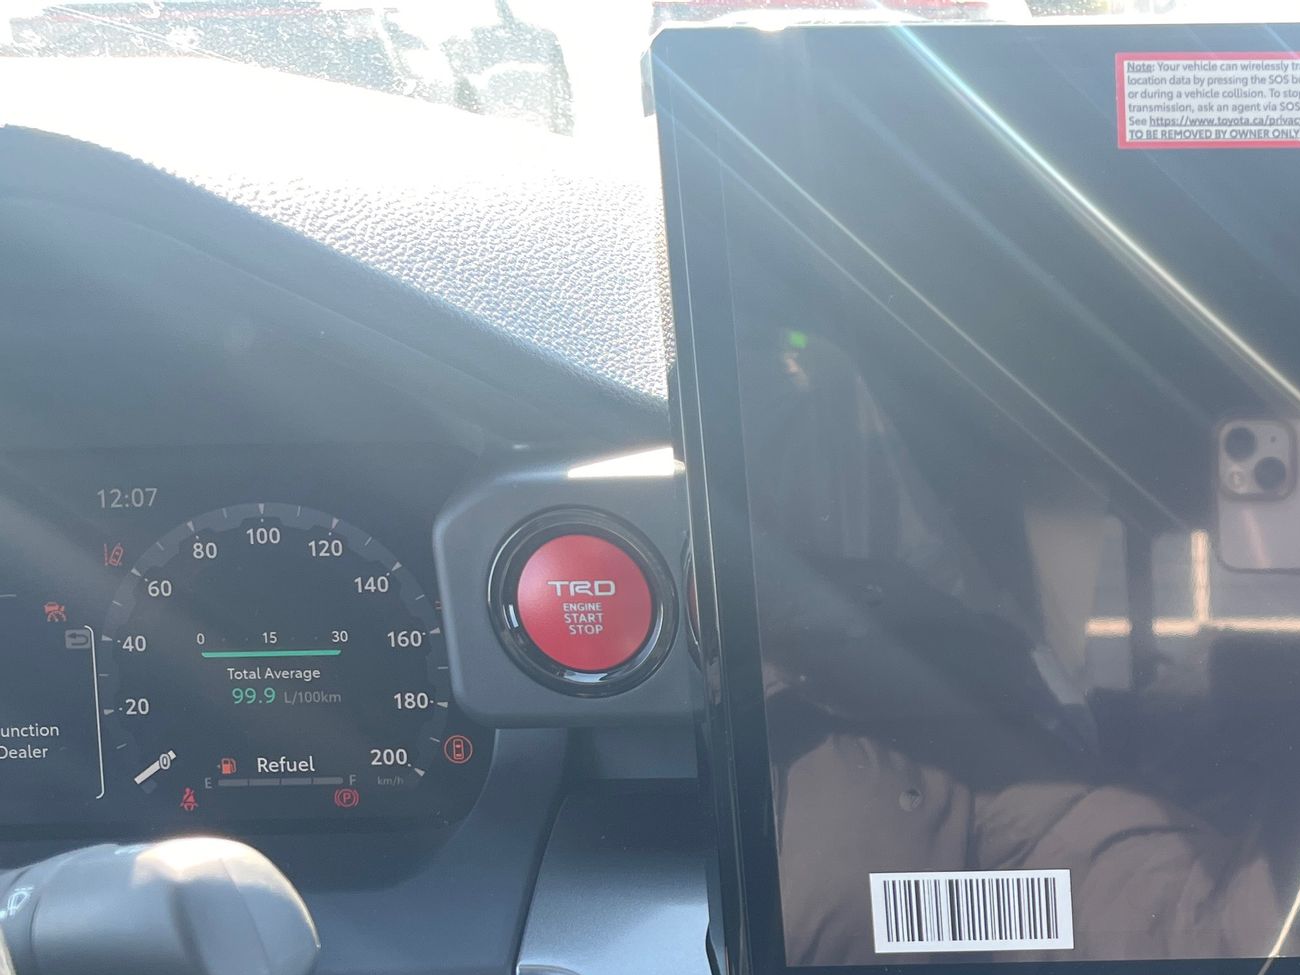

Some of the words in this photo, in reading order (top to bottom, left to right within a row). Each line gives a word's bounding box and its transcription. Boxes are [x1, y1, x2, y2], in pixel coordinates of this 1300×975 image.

[1127, 62, 1155, 73] Note:
[1157, 62, 1180, 72] Your
[1183, 61, 1218, 72] vehicle
[1220, 63, 1238, 71] can
[1240, 61, 1289, 72] wirelessly
[1127, 75, 1166, 85] location
[1169, 75, 1191, 85] data
[1193, 75, 1205, 87] by
[1207, 75, 1248, 87] pressing
[1250, 75, 1266, 84] the
[1268, 75, 1289, 84] SOS
[1128, 91, 1138, 99] or
[1140, 89, 1173, 100] during
[1176, 90, 1182, 98] a
[1184, 88, 1220, 98] vehicle
[1221, 88, 1267, 98] collision.
[1269, 88, 1280, 98] To
[1128, 102, 1194, 113] transmission,
[1197, 102, 1215, 112] ask
[1216, 104, 1229, 112] an
[1231, 102, 1261, 114] agent
[1263, 102, 1277, 111] via
[1128, 116, 1147, 126] See
[1129, 129, 1144, 140] TO
[1146, 129, 1158, 140] BE
[1161, 129, 1212, 140] REMOVED
[1214, 129, 1228, 139] BY
[1229, 129, 1270, 139] OWNER
[1272, 129, 1300, 139] ONLY
[97, 488, 158, 509] 12:07
[246, 527, 281, 545] 100
[192, 542, 218, 560] 80
[308, 539, 343, 558] 120
[147, 580, 172, 598] 60
[354, 576, 389, 594] 140
[548, 580, 616, 596] TRD
[563, 602, 602, 612] ENGINE
[564, 613, 604, 623] START
[331, 630, 349, 643] 30
[569, 624, 604, 635] STOP
[122, 636, 147, 652] 40
[196, 633, 205, 645] 0
[262, 632, 278, 644] 15
[387, 630, 422, 648] 160
[227, 667, 261, 680] Total
[264, 667, 321, 682] Average
[232, 687, 276, 704] 99.9
[284, 690, 341, 705] L/100km
[394, 693, 430, 710] 180
[125, 699, 149, 715] 20
[0, 744, 49, 759] Dealer
[370, 749, 408, 766] 200
[159, 753, 171, 770] 0
[257, 755, 316, 773] Refuel
[204, 778, 213, 789] E
[349, 775, 357, 786] F
[377, 775, 404, 787] km/h
